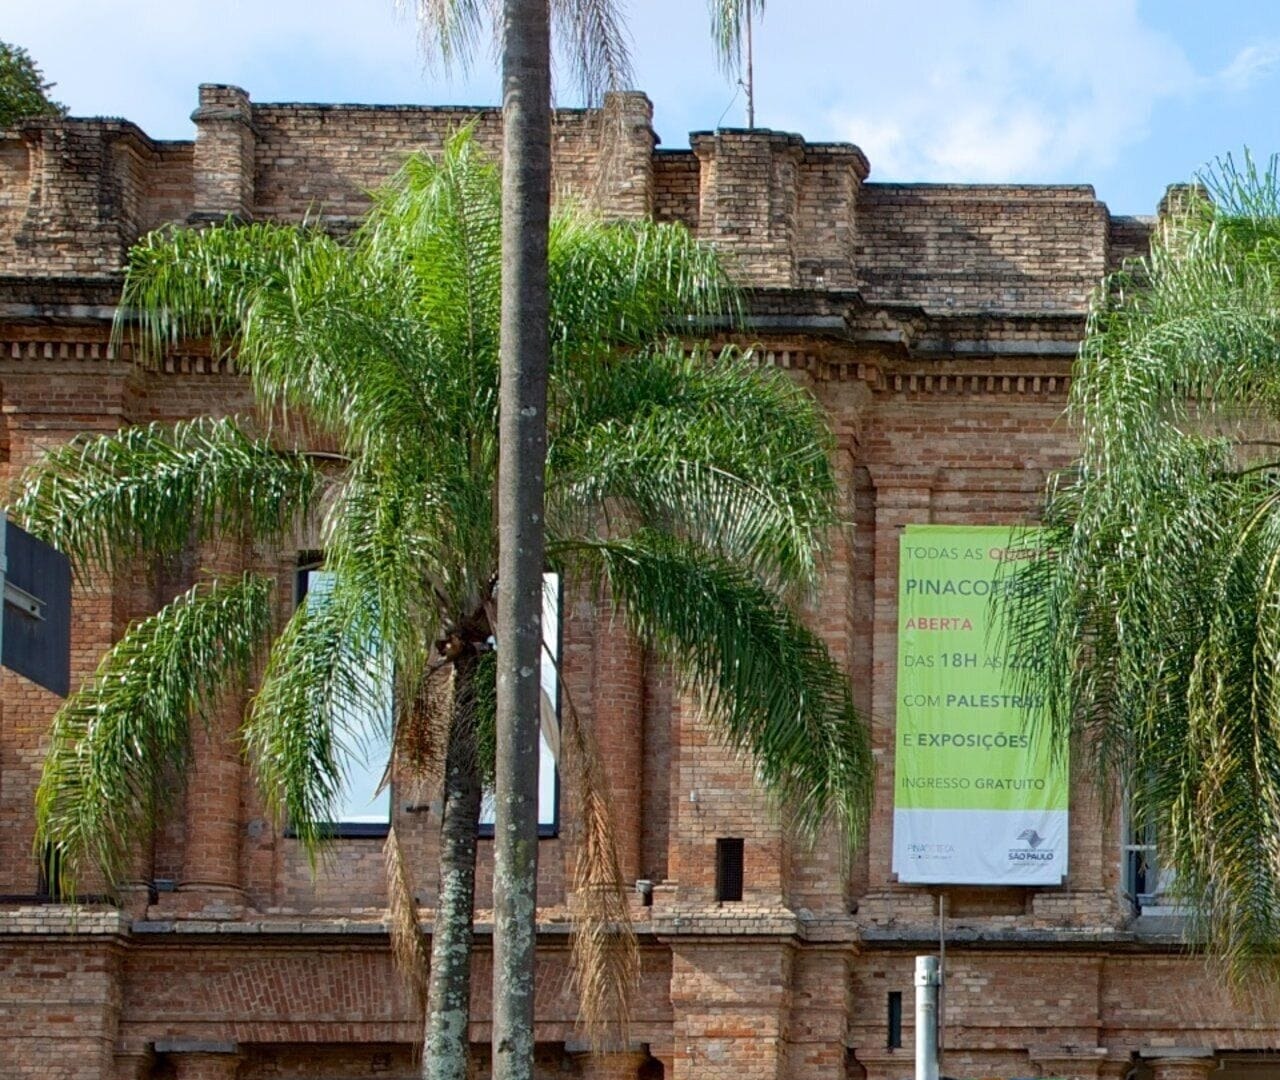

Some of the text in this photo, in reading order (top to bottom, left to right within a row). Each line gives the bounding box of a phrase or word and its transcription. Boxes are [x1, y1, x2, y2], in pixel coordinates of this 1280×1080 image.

[905, 547, 958, 560] TODAS
[963, 548, 983, 560] AS
[905, 617, 972, 631] ABERTA
[904, 655, 934, 668] DAS
[941, 653, 977, 668] 18H
[903, 694, 941, 708] COM
[902, 732, 1029, 751] E EXPOSIÇÕES
[902, 777, 1046, 791] INGRESSO GRATUITO
[1008, 851, 1054, 861] SÃO PAULO
